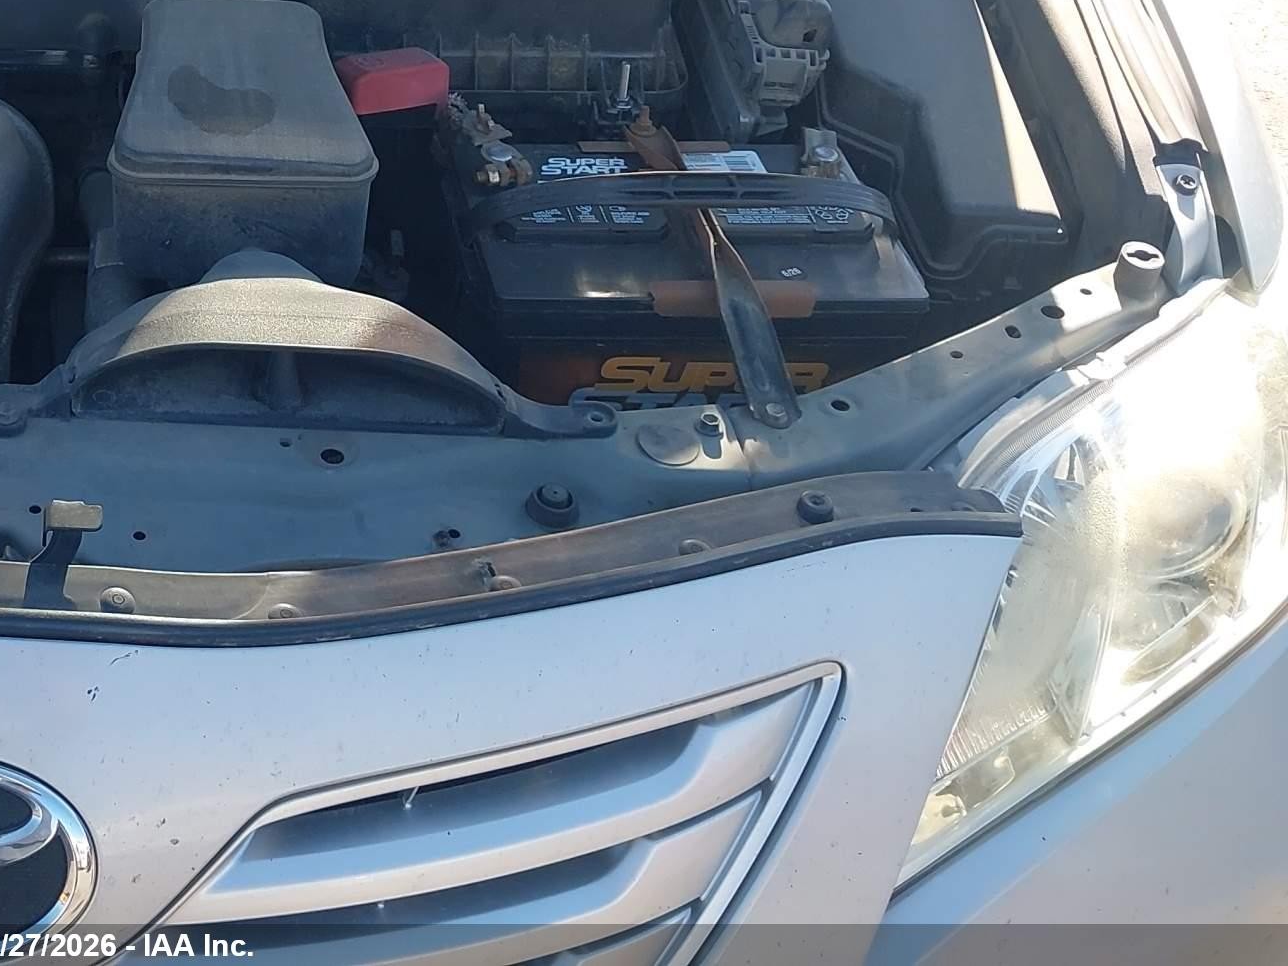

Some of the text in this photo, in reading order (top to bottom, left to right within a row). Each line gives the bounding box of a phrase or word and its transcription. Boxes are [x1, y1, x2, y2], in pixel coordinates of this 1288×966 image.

[547, 157, 626, 168] SUPER
[540, 165, 628, 175] START
[594, 356, 830, 393] SUPR
